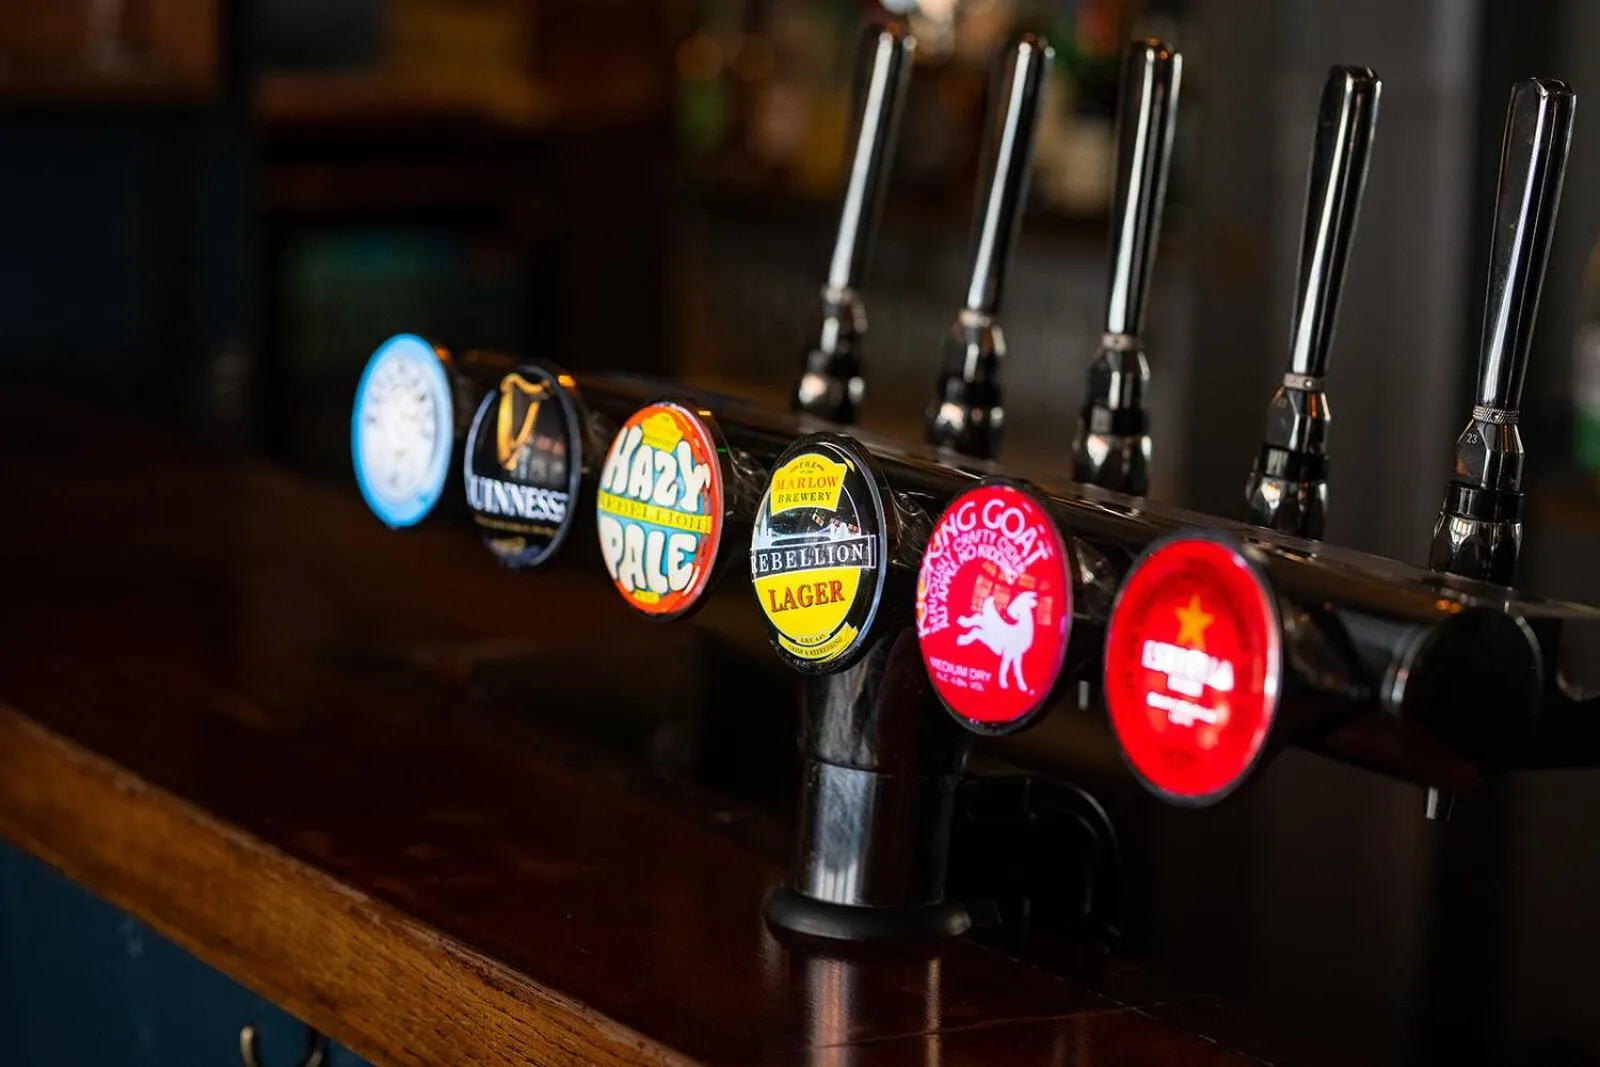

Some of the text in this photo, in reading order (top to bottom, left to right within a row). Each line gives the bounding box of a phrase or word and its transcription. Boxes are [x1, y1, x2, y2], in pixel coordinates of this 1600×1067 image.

[1466, 433, 1478, 444] 23
[601, 424, 711, 513] HAZY
[775, 475, 839, 491] MARLOW
[467, 474, 569, 523] UINNESS
[777, 491, 832, 504] BREWERY
[953, 528, 997, 552] CRAFTY
[982, 498, 1050, 567] GOAT
[598, 515, 697, 595] PALE
[751, 543, 866, 575] REBELLION
[959, 545, 977, 564] NO
[767, 579, 846, 613] LAGER
[929, 656, 993, 682] MEDIUM DRY
